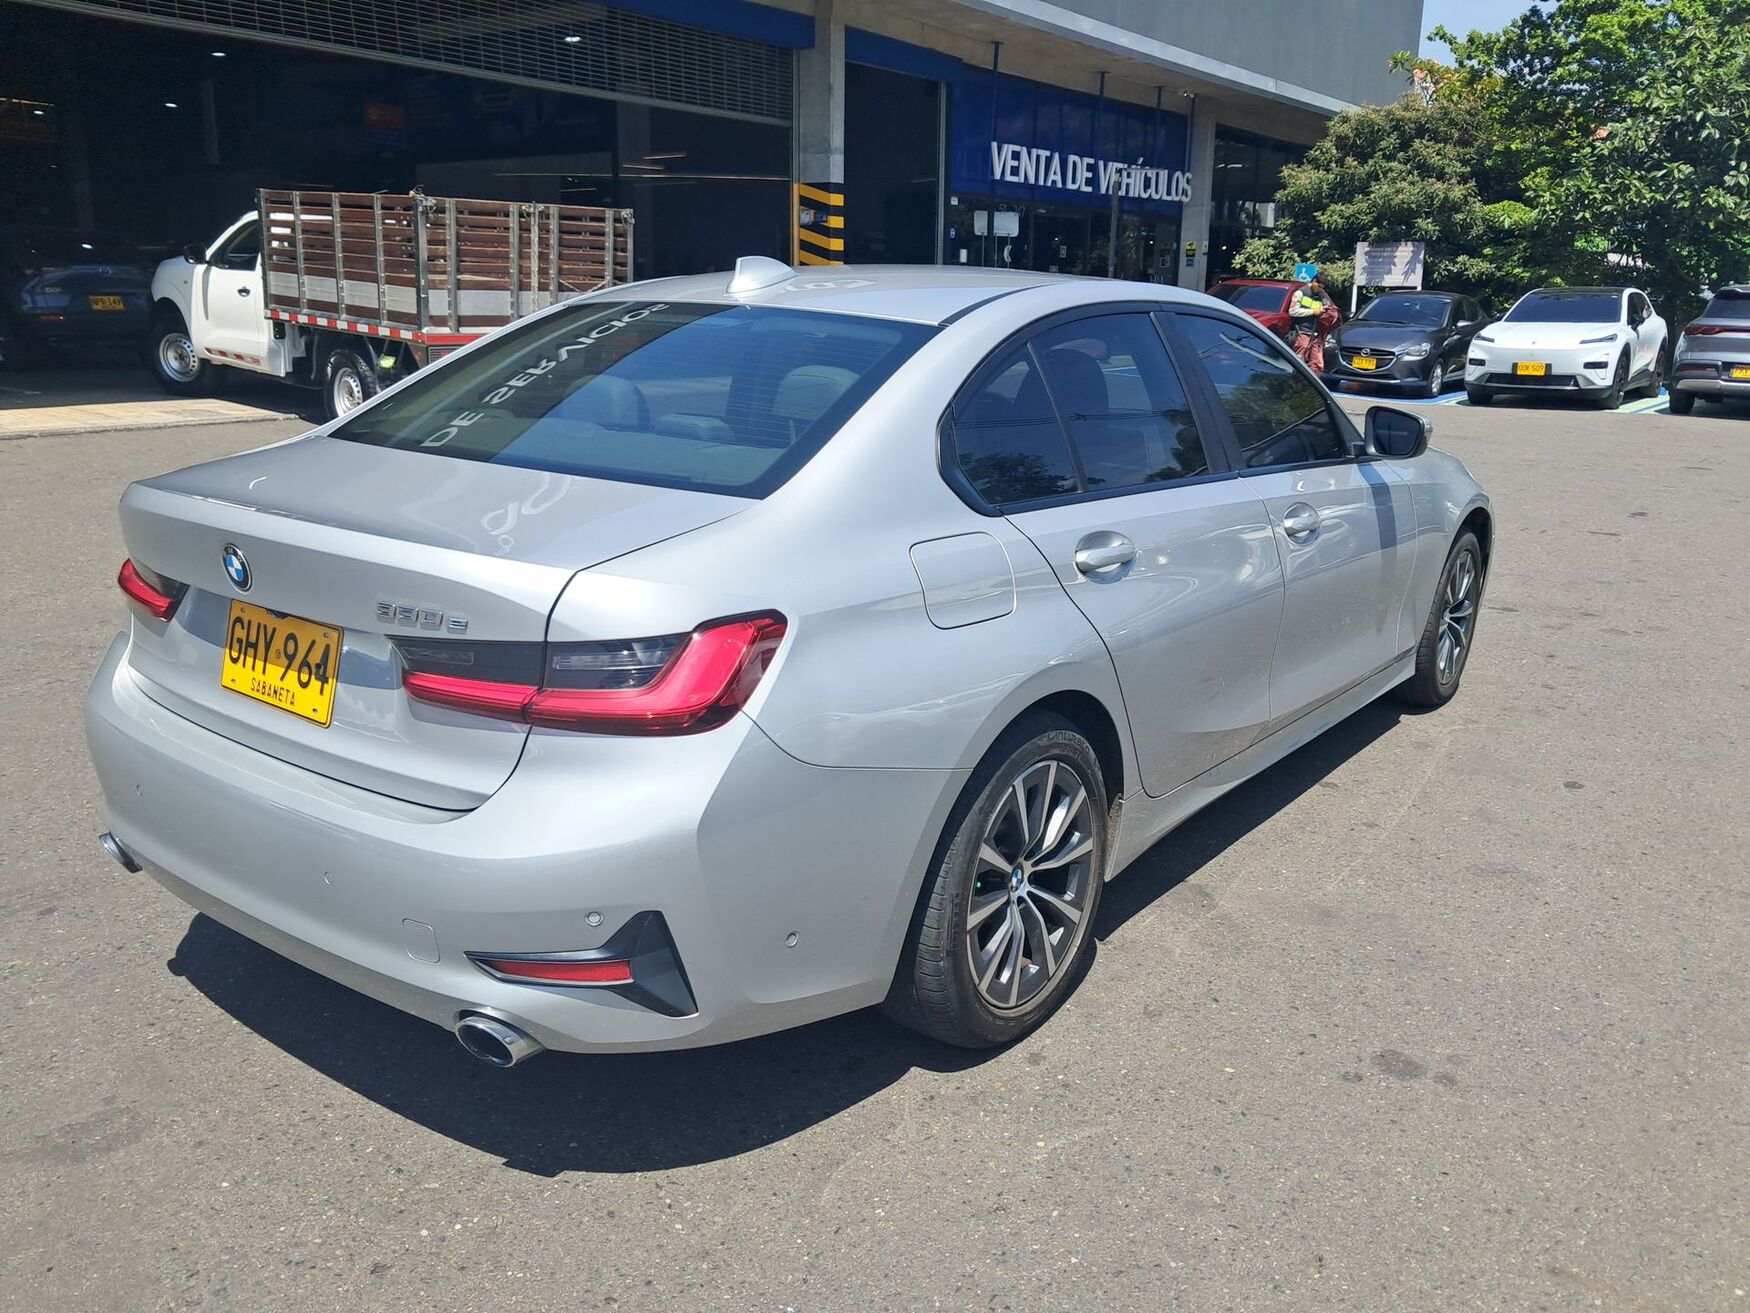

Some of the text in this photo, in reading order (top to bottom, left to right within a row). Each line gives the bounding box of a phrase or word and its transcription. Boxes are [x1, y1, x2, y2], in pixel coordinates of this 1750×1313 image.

[990, 141, 1063, 188] VENTA
[1066, 154, 1095, 192] DE
[228, 616, 331, 696] GHY 964
[250, 677, 295, 706] SABANETA
